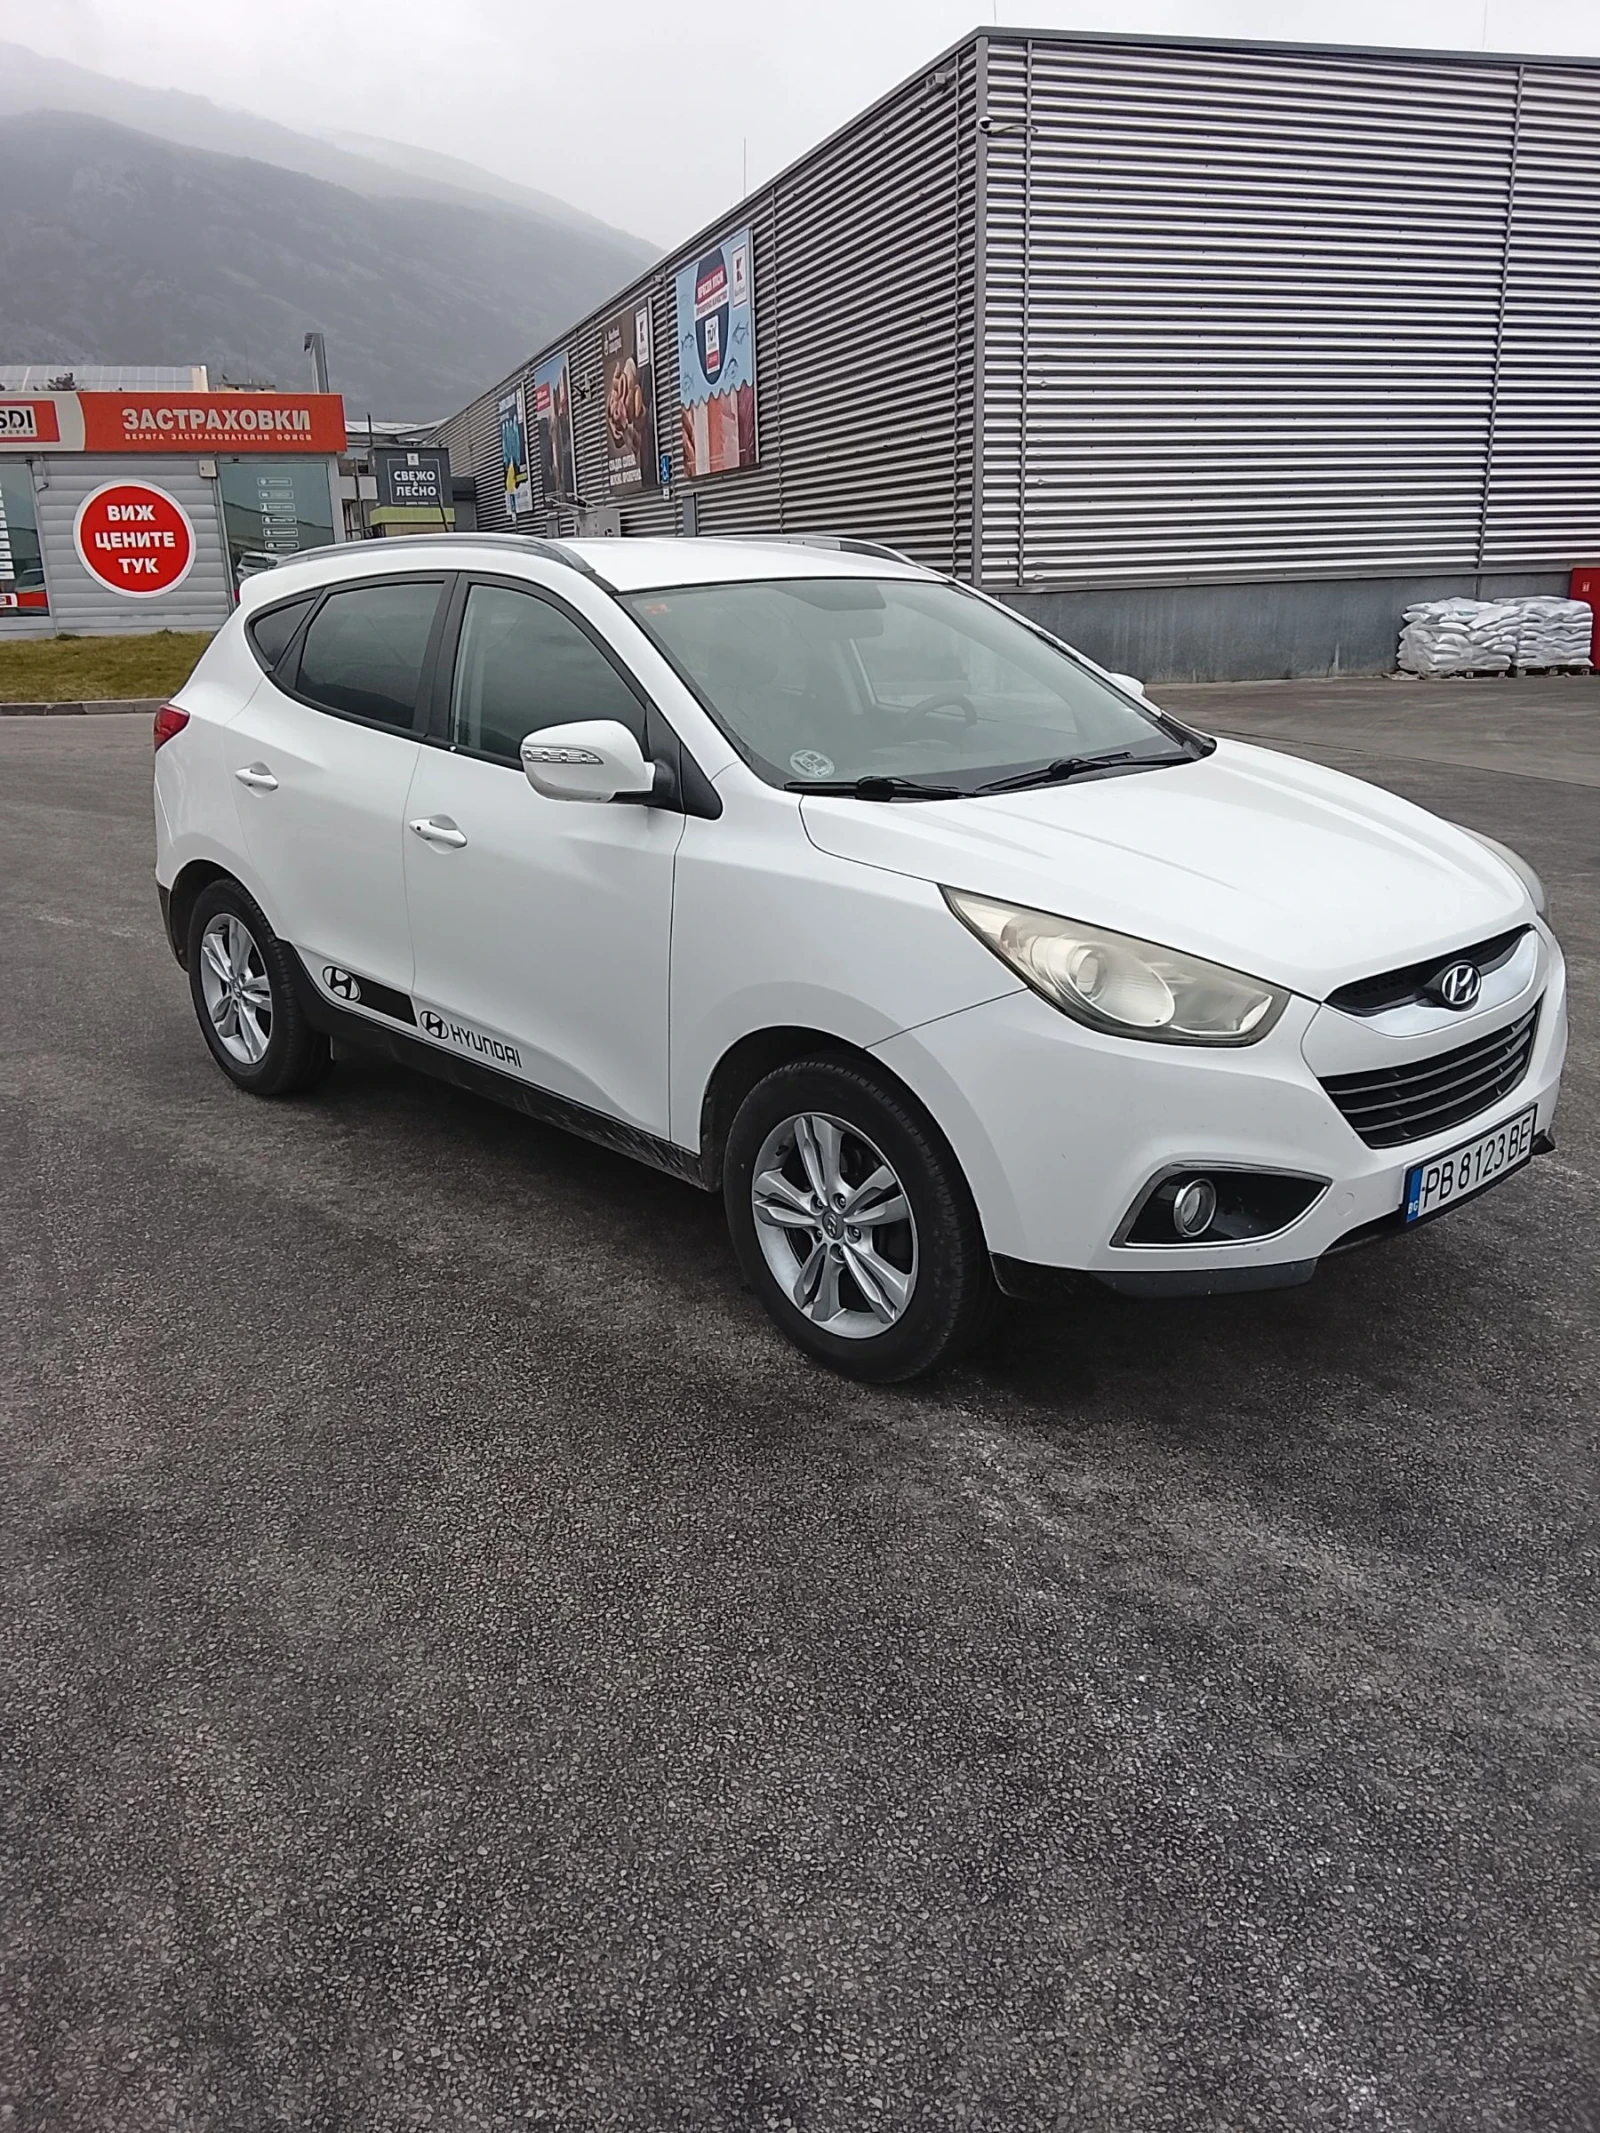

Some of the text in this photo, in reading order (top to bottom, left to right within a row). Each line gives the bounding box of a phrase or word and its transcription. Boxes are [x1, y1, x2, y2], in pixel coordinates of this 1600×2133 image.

[122, 409, 311, 431] ЗАСТРАХОВКИ
[394, 471, 435, 481] СВЕЖО
[396, 486, 437, 496] ЛЕСНО
[107, 504, 156, 521] ВИЖ
[95, 531, 175, 551] ЦЕНИТЕ
[118, 558, 159, 574] ТУК
[450, 1023, 523, 1069] HYUNDAI
[1423, 1116, 1531, 1209] PB 8123 BE
[1408, 1200, 1419, 1214] BG
